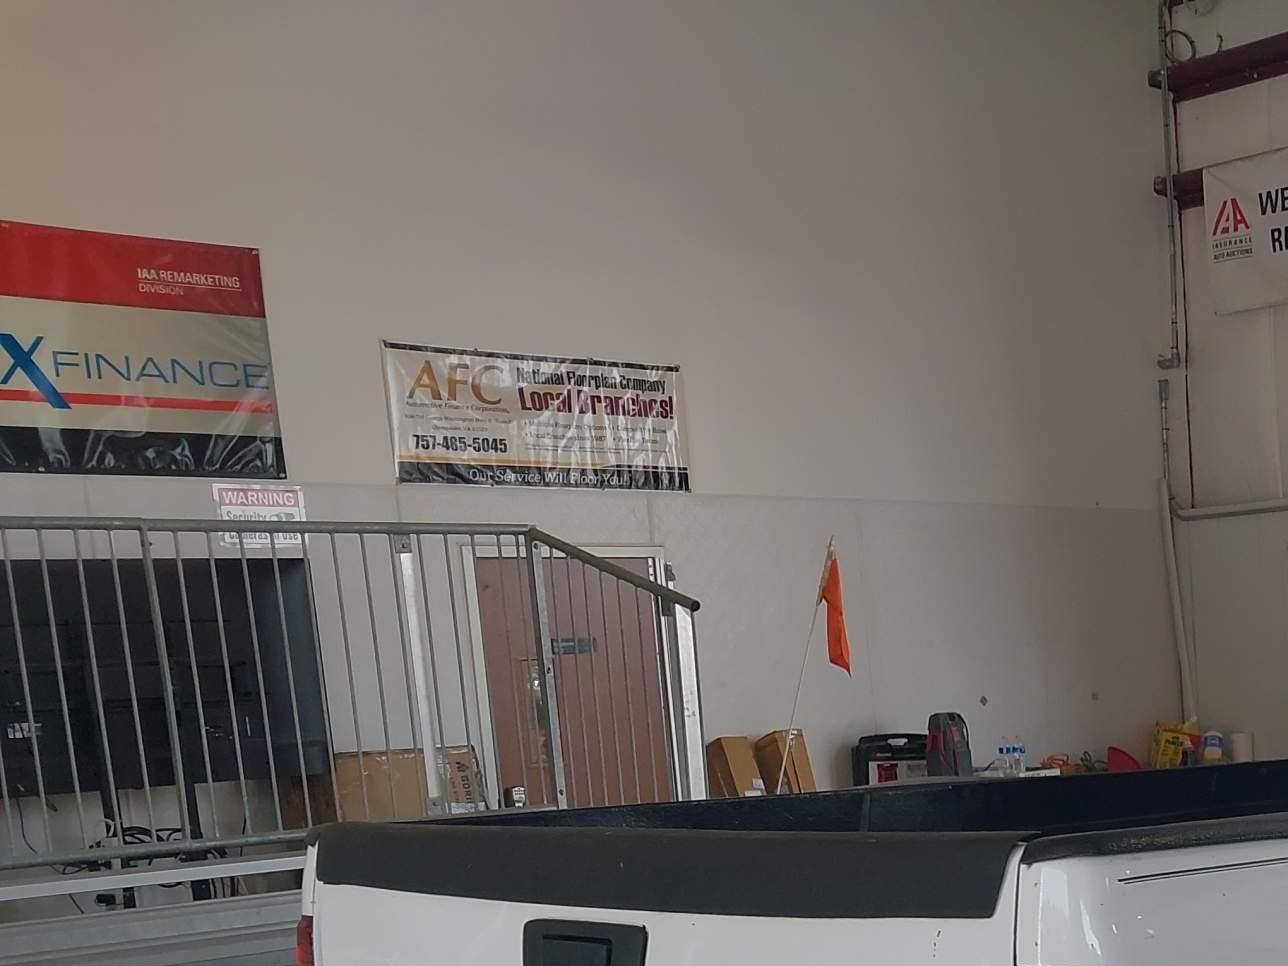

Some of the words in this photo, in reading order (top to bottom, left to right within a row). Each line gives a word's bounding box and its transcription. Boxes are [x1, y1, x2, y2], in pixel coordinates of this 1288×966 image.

[137, 267, 158, 280] IAA
[159, 269, 240, 289] REMARKETING
[138, 283, 184, 296] DIVISION
[406, 358, 504, 406] AFC
[517, 386, 573, 414] Local
[469, 468, 493, 482] Our
[494, 469, 542, 484] Service
[543, 471, 568, 485] Will
[222, 491, 296, 506] WARNING
